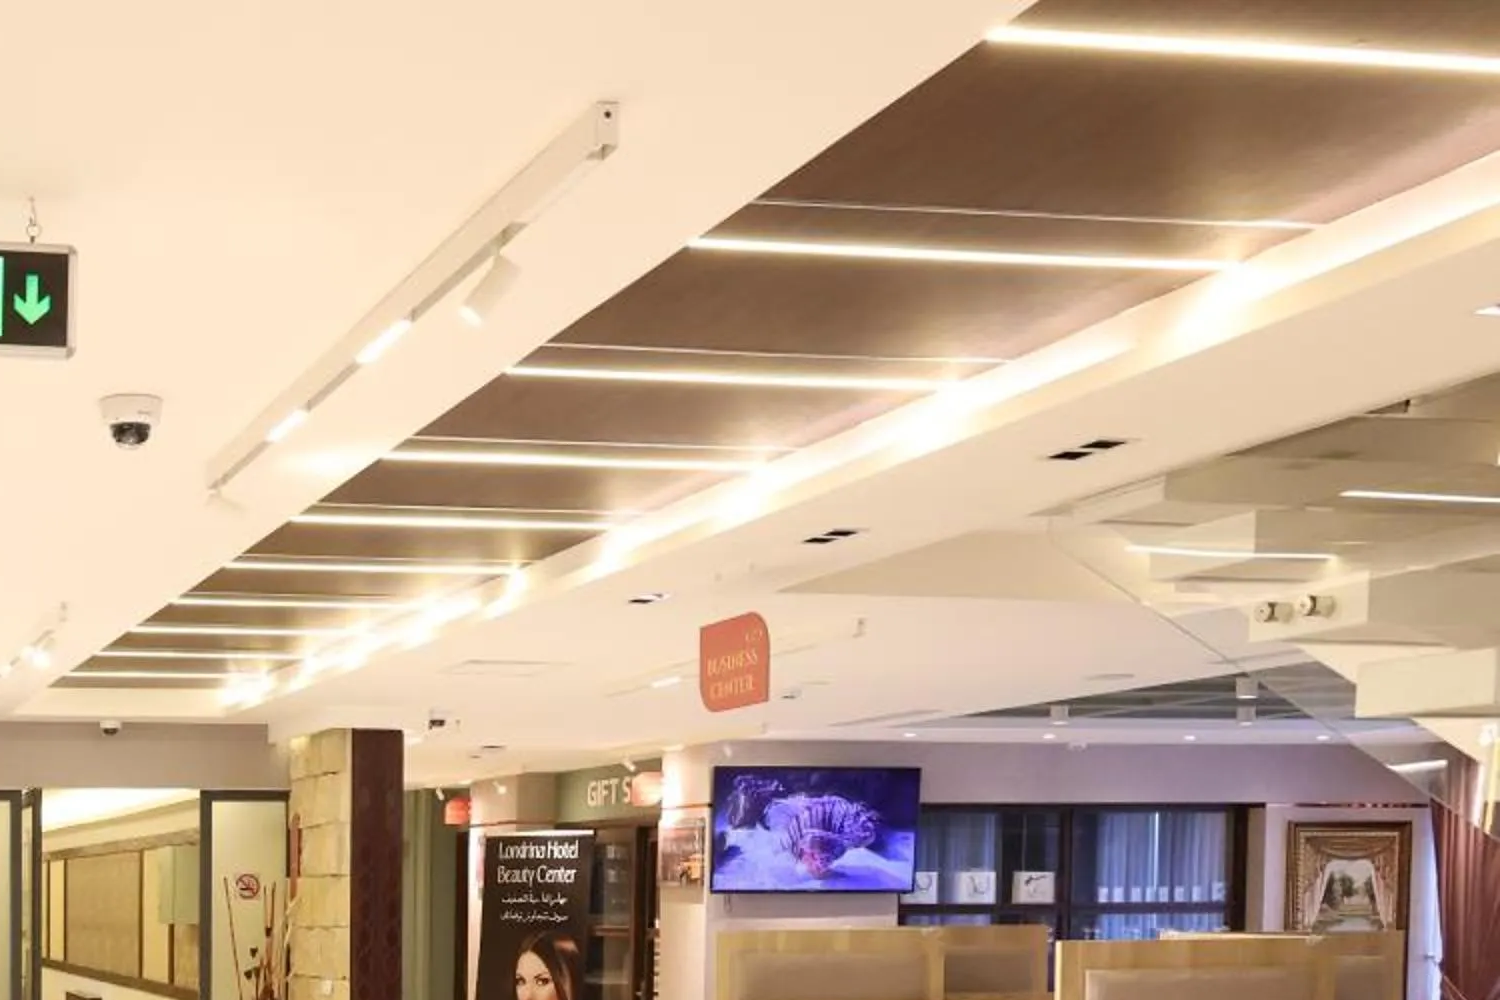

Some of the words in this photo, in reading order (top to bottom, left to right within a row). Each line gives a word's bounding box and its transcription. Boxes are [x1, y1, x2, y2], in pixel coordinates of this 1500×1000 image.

[587, 778, 619, 808] GIFT
[498, 840, 546, 860] Londrina
[547, 838, 580, 860] Hotel
[496, 865, 535, 888] Beauty
[536, 865, 577, 884] Center
